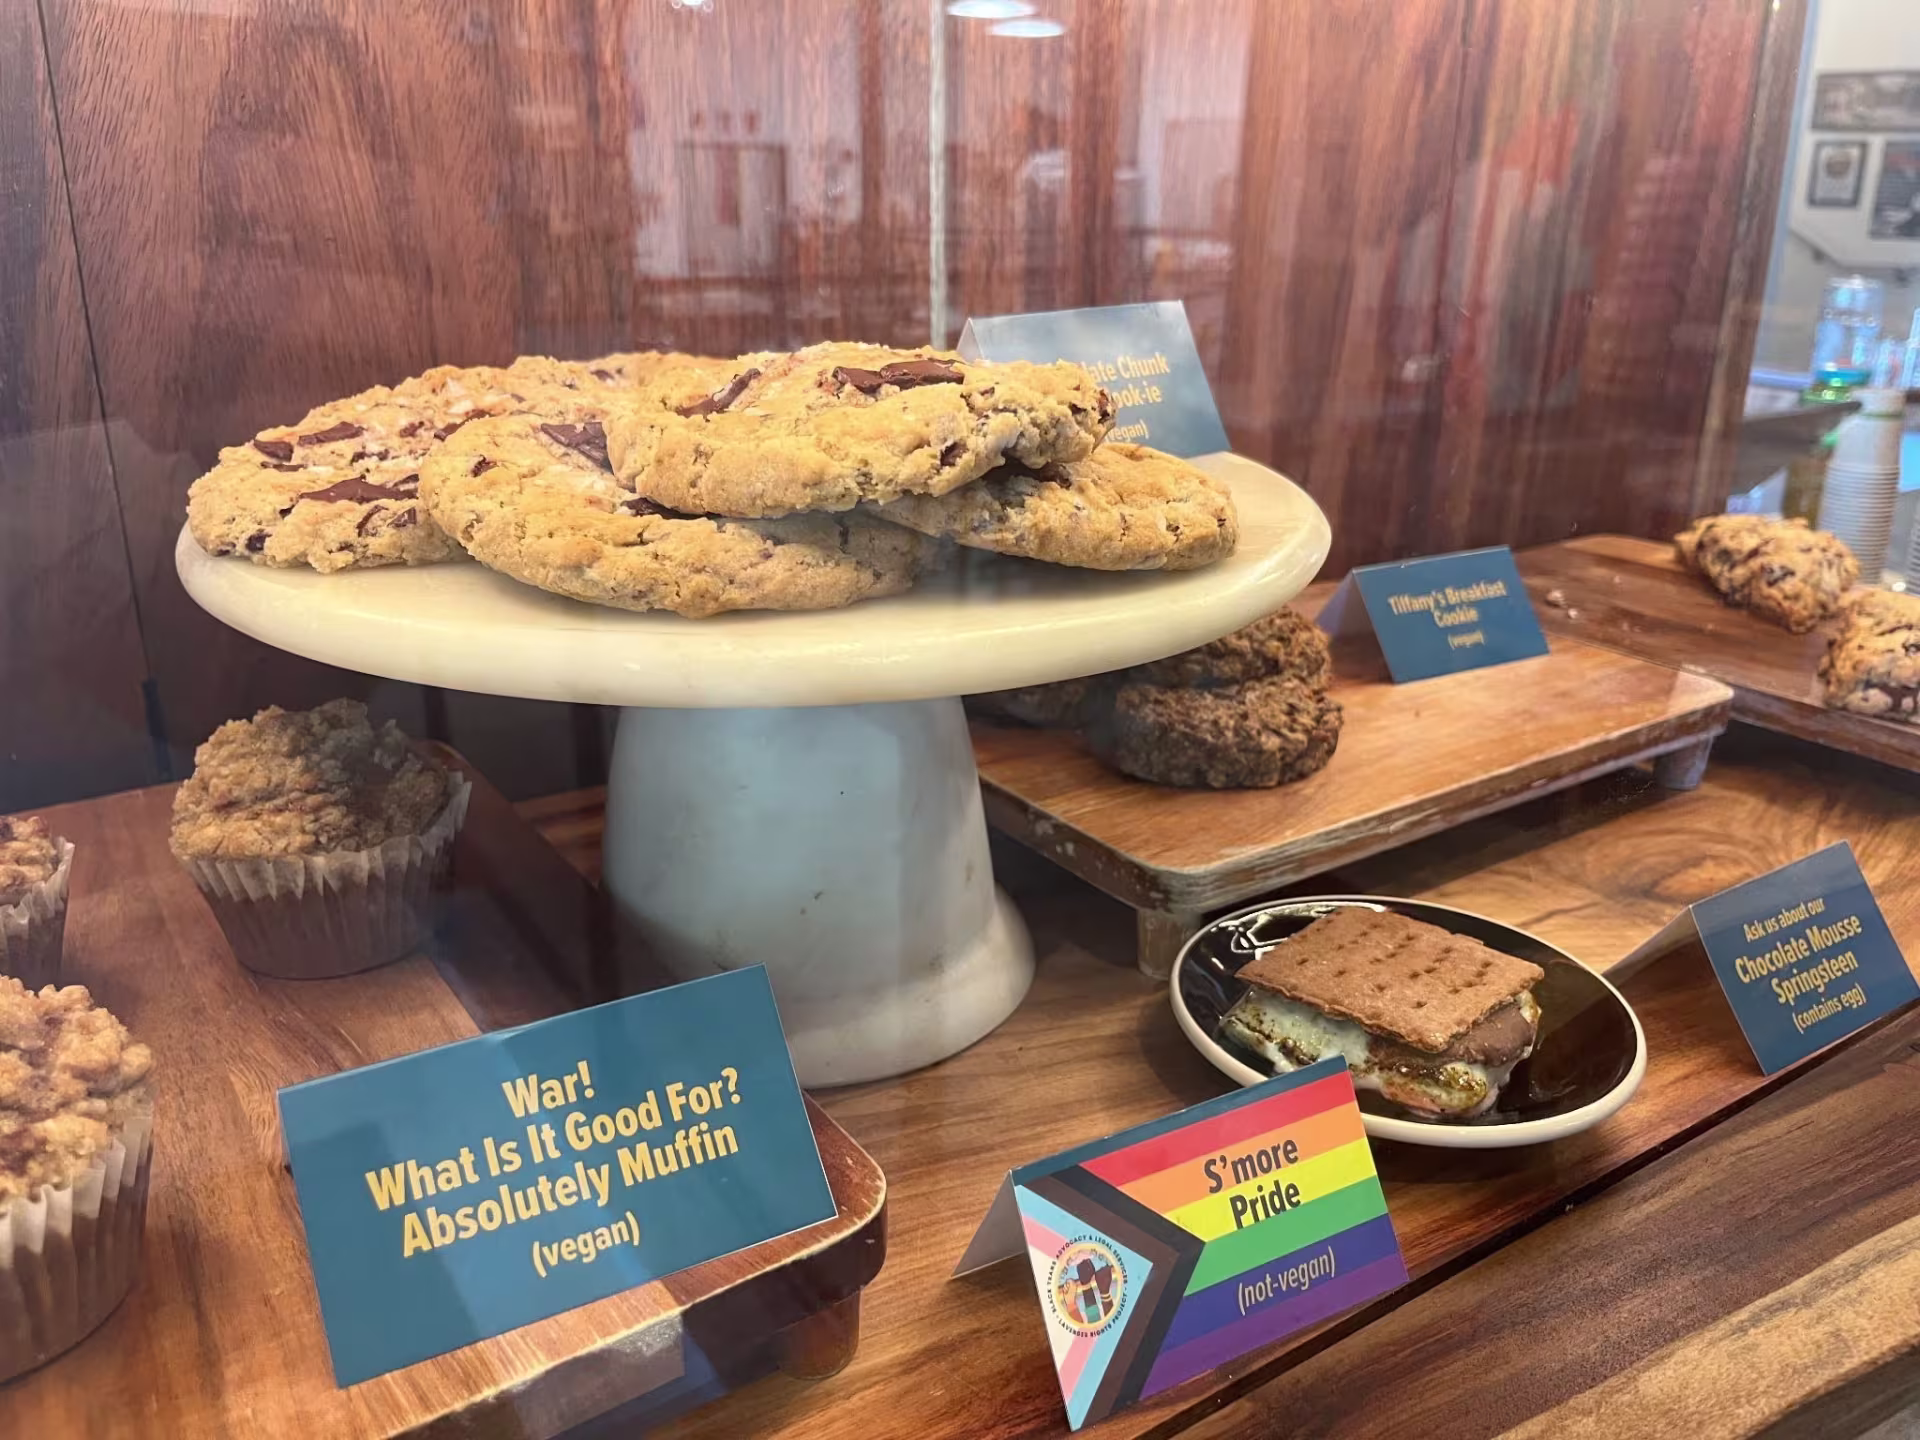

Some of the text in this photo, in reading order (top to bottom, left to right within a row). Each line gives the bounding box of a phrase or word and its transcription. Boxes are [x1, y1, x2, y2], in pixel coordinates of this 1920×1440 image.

[1117, 351, 1170, 378] Chunk
[1110, 381, 1162, 408] ook-ie
[1433, 605, 1479, 628] Cookie
[1445, 580, 1507, 605] Breakfast
[1743, 897, 1826, 943] Ask us about our
[1735, 914, 1862, 984] Chocolate Mousse
[1771, 950, 1859, 1006] Springsteen
[1791, 982, 1867, 1034] (contains egg)
[502, 1060, 595, 1119] War!
[364, 1066, 743, 1211] What Is It Good For?
[1203, 1138, 1299, 1195] S’more
[402, 1121, 739, 1258] Absolutely Muffin
[1229, 1180, 1302, 1231] Pride
[531, 1211, 641, 1278] (vegan)
[1237, 1245, 1337, 1315] (not-vegan)
